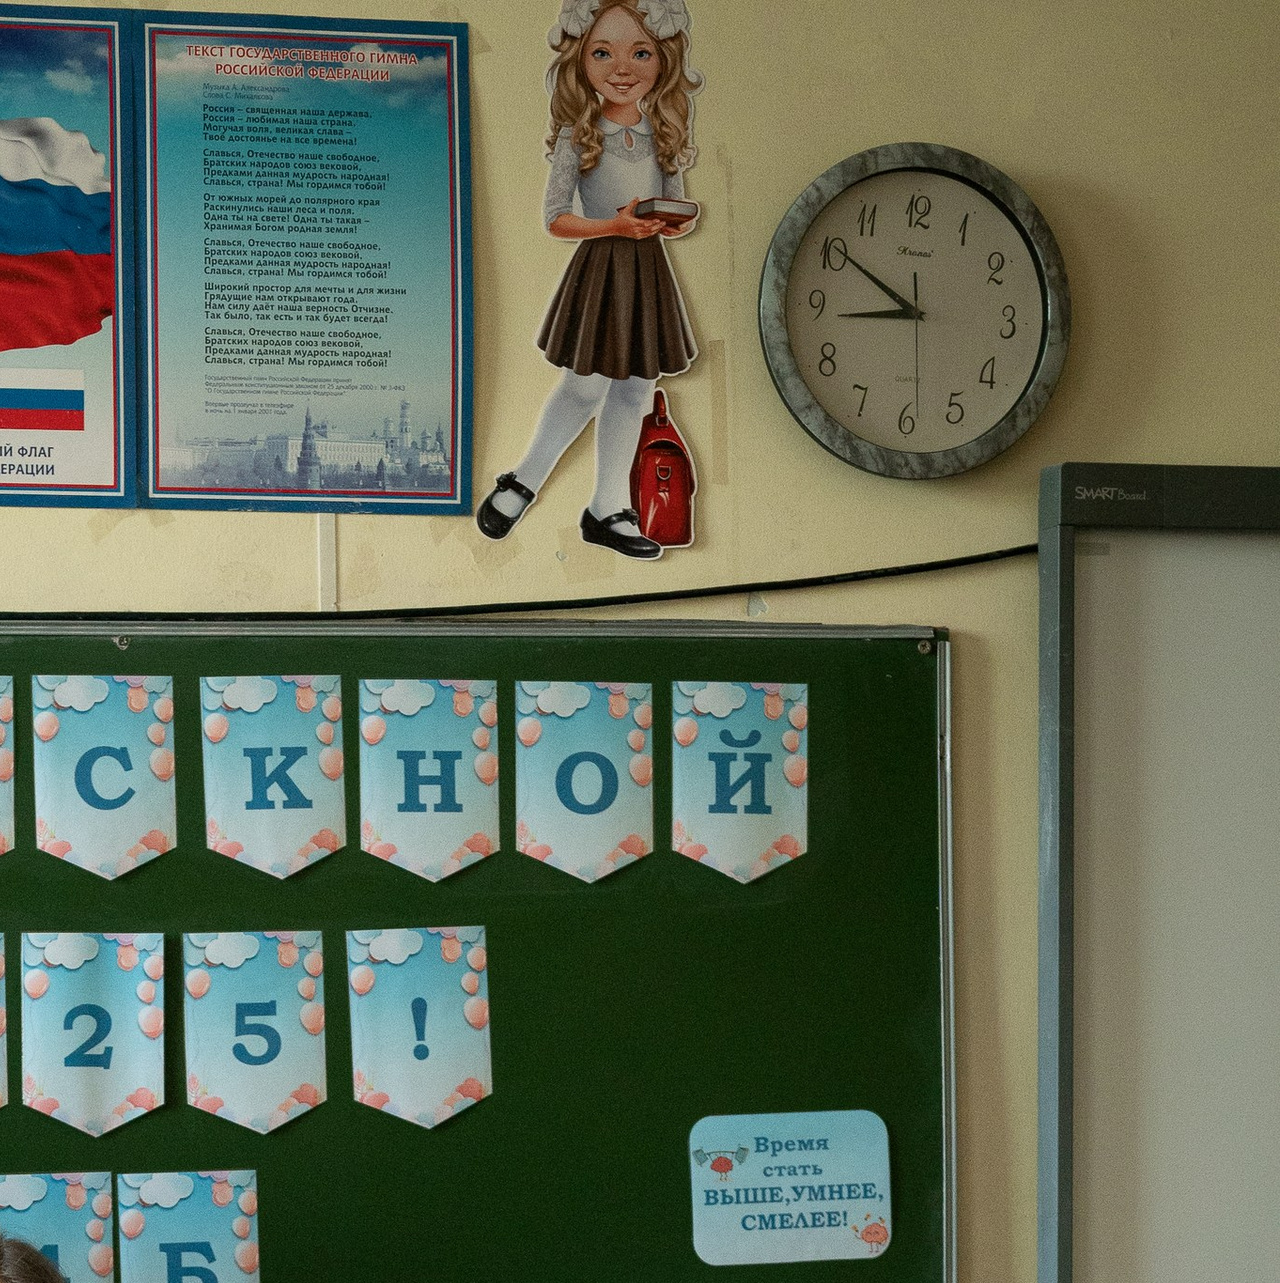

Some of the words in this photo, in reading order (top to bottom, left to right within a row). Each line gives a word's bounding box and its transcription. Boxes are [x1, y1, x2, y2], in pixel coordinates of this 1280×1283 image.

[186, 45, 226, 57] ТЕКСТ
[229, 46, 365, 63] ГОСУДАРСТВЕННОГО
[370, 52, 418, 65] ГИМНА
[215, 63, 304, 77] РОССИЙСКОЙ
[308, 67, 390, 82] ФЕДЕРАЦИИ
[202, 104, 235, 114] Россия
[245, 108, 298, 117] священная
[202, 114, 235, 123] Россия
[245, 115, 290, 125] любимая
[292, 118, 318, 126] наша
[202, 123, 244, 135] Могучая
[275, 127, 314, 135] великая
[316, 128, 344, 136] слава
[228, 136, 278, 145] достоянье
[203, 193, 216, 202] От
[218, 195, 253, 203] южных
[255, 194, 287, 206] морей
[288, 197, 302, 206] до
[304, 198, 356, 207] полярного
[358, 199, 380, 208] края
[204, 202, 264, 215] Раскинулись
[267, 206, 293, 214] наши
[203, 212, 228, 223] Одна
[260, 213, 290, 223] свете!
[292, 214, 318, 226] Одна
[336, 217, 362, 225] такая
[905, 194, 931, 229] 12
[204, 221, 252, 233] Хранимая
[255, 223, 285, 232] Богом
[287, 226, 322, 235] родная
[325, 224, 357, 234] земля!
[857, 204, 877, 236] 11
[958, 213, 969, 246] 1
[203, 237, 245, 249] Славься,
[248, 238, 297, 249] Отечество
[327, 240, 381, 252] свободное,
[204, 247, 248, 259] Братских
[250, 250, 292, 260] народов
[294, 251, 318, 259] союз
[820, 236, 847, 271] 10
[204, 256, 254, 268] Предками
[256, 260, 291, 269] данная
[293, 261, 339, 271] мудрость
[341, 260, 391, 272] народная!
[987, 252, 1005, 285] 2
[204, 266, 245, 278] Славься,
[248, 267, 284, 279] страна!
[287, 268, 304, 277] Мы
[307, 271, 353, 280] гордимся
[356, 270, 387, 280] тобой!
[204, 282, 250, 294] Широкий
[252, 285, 292, 295] простор
[294, 286, 312, 295] для
[356, 288, 374, 297] для
[376, 288, 407, 296] жизни
[204, 291, 252, 303] Грядущие
[277, 295, 330, 305] открывают
[809, 289, 826, 321] 9
[204, 301, 226, 310] Нам
[228, 304, 250, 313] силу
[305, 306, 349, 315] верность
[205, 310, 221, 320] Так
[224, 311, 252, 322] было,
[273, 314, 294, 322] есть
[322, 313, 351, 325] будет
[353, 314, 388, 326] всегда!
[1000, 305, 1016, 339] 3
[204, 326, 246, 338] Славься,
[248, 327, 298, 338] Отечество
[328, 329, 382, 341] свободное,
[204, 335, 248, 348] Братских
[251, 339, 292, 349] народов
[294, 340, 318, 348] союз
[204, 345, 254, 357] Предками
[256, 349, 292, 358] данная
[294, 350, 340, 359] мудрость
[342, 349, 392, 361] народная!
[819, 343, 836, 376] 8
[204, 355, 246, 367] Славься,
[248, 356, 285, 368] страна!
[288, 357, 305, 366] Мы
[308, 360, 353, 369] гордимся
[356, 359, 388, 369] тобой!
[979, 356, 996, 389] 4
[852, 384, 868, 417] 7
[946, 391, 964, 424] 5
[898, 401, 915, 435] 6
[17, 446, 54, 458] ФЛАГ
[1074, 486, 1118, 500] SMART
[754, 1136, 829, 1157] Время
[763, 1162, 823, 1178] стать
[741, 1211, 848, 1231] СМЕЛЕЕ!
